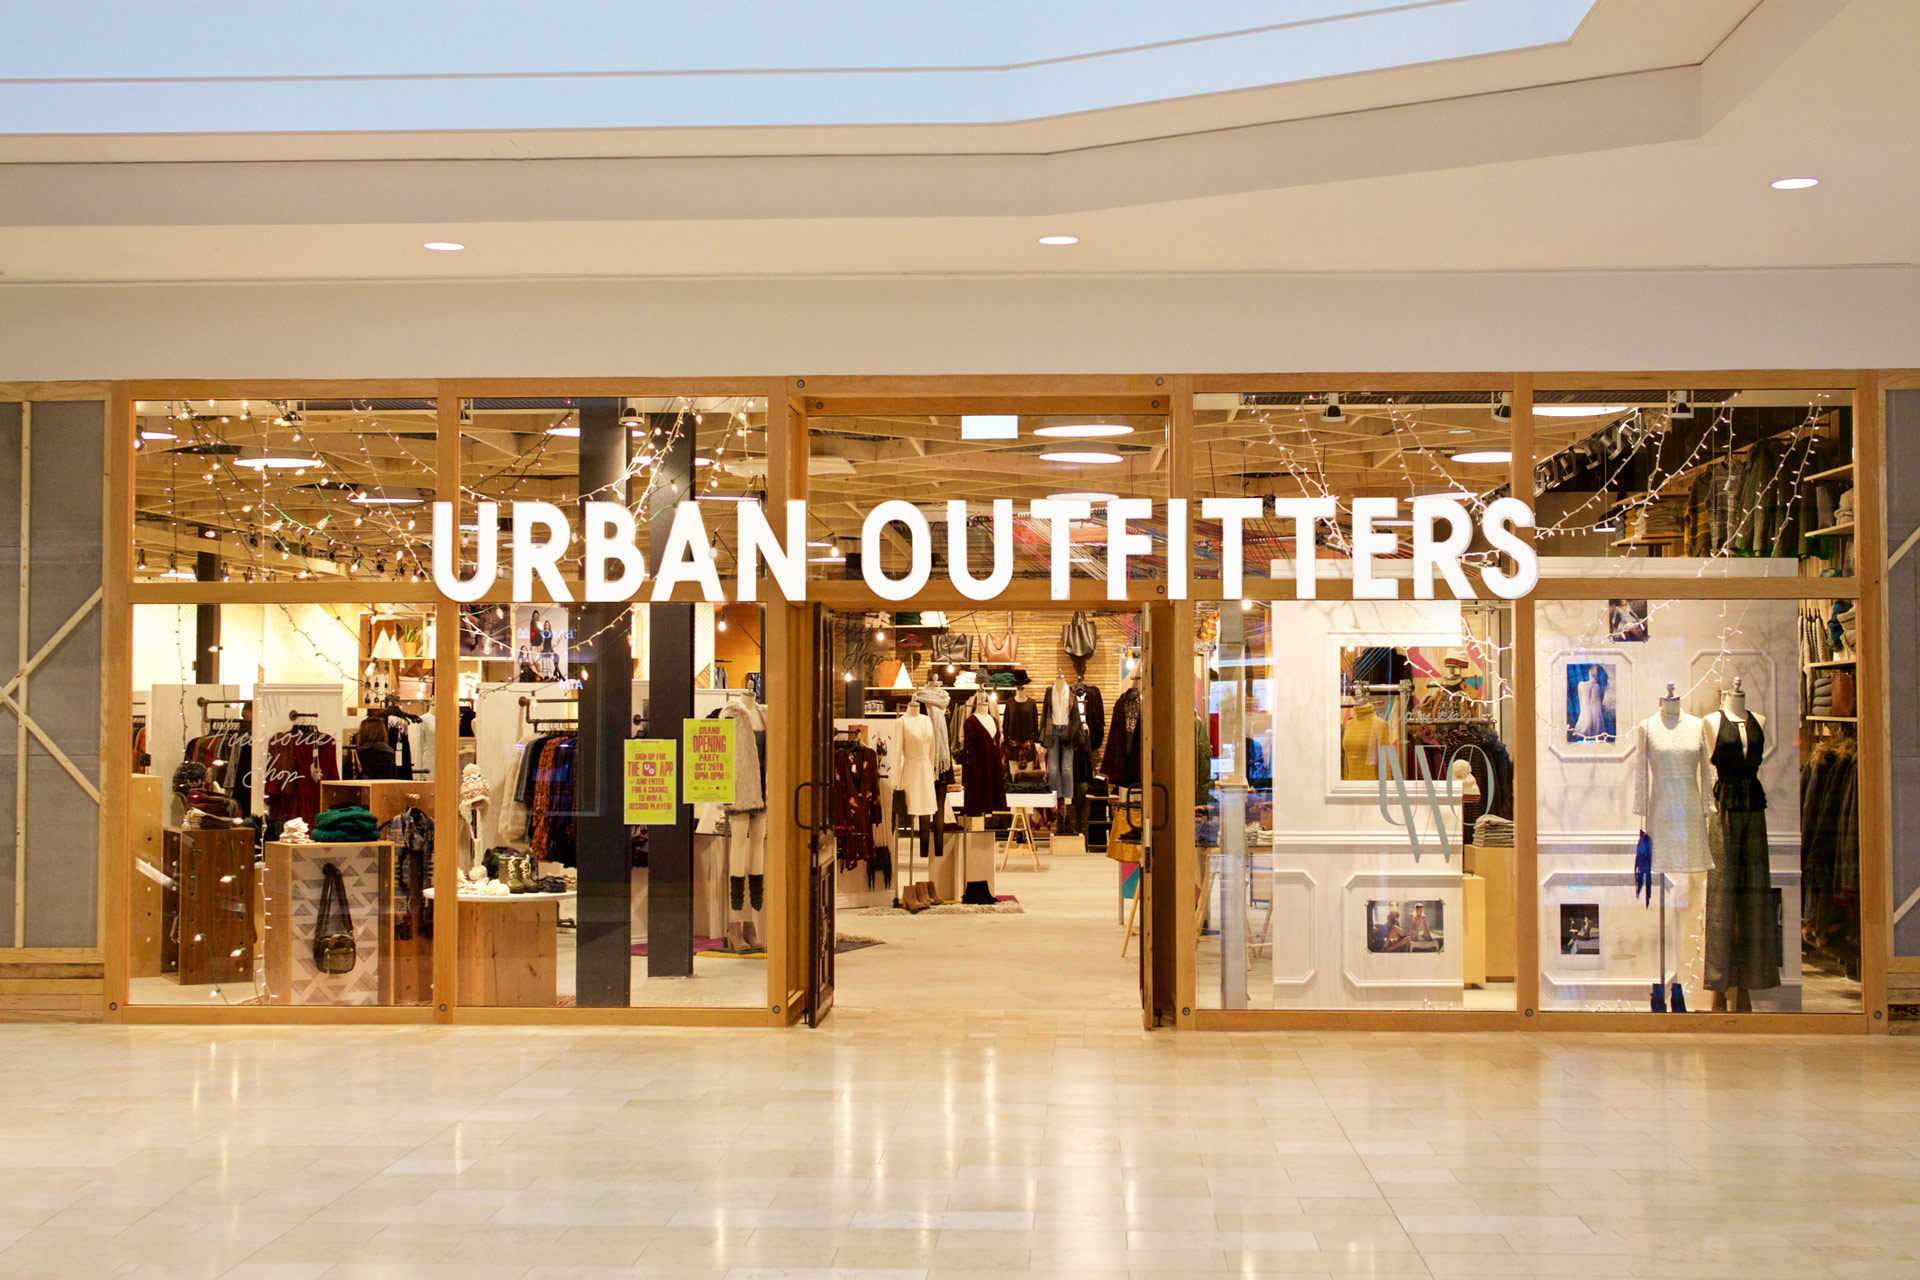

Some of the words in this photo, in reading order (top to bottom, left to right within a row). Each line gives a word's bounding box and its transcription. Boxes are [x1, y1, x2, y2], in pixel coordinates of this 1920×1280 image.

[433, 500, 807, 602] URBAN
[861, 496, 1538, 601] OUTFITTERS
[699, 726, 720, 735] GRAND
[693, 735, 726, 753] OPENING
[635, 753, 647, 761] SIGN
[648, 753, 655, 761] UP
[656, 753, 666, 761] FOR
[699, 754, 720, 762] PARTY
[242, 751, 306, 791] Shop
[628, 761, 640, 777] THE
[660, 761, 674, 777] APP
[695, 762, 706, 771] OCT
[639, 794, 645, 802] TO
[646, 794, 657, 802] WIN
